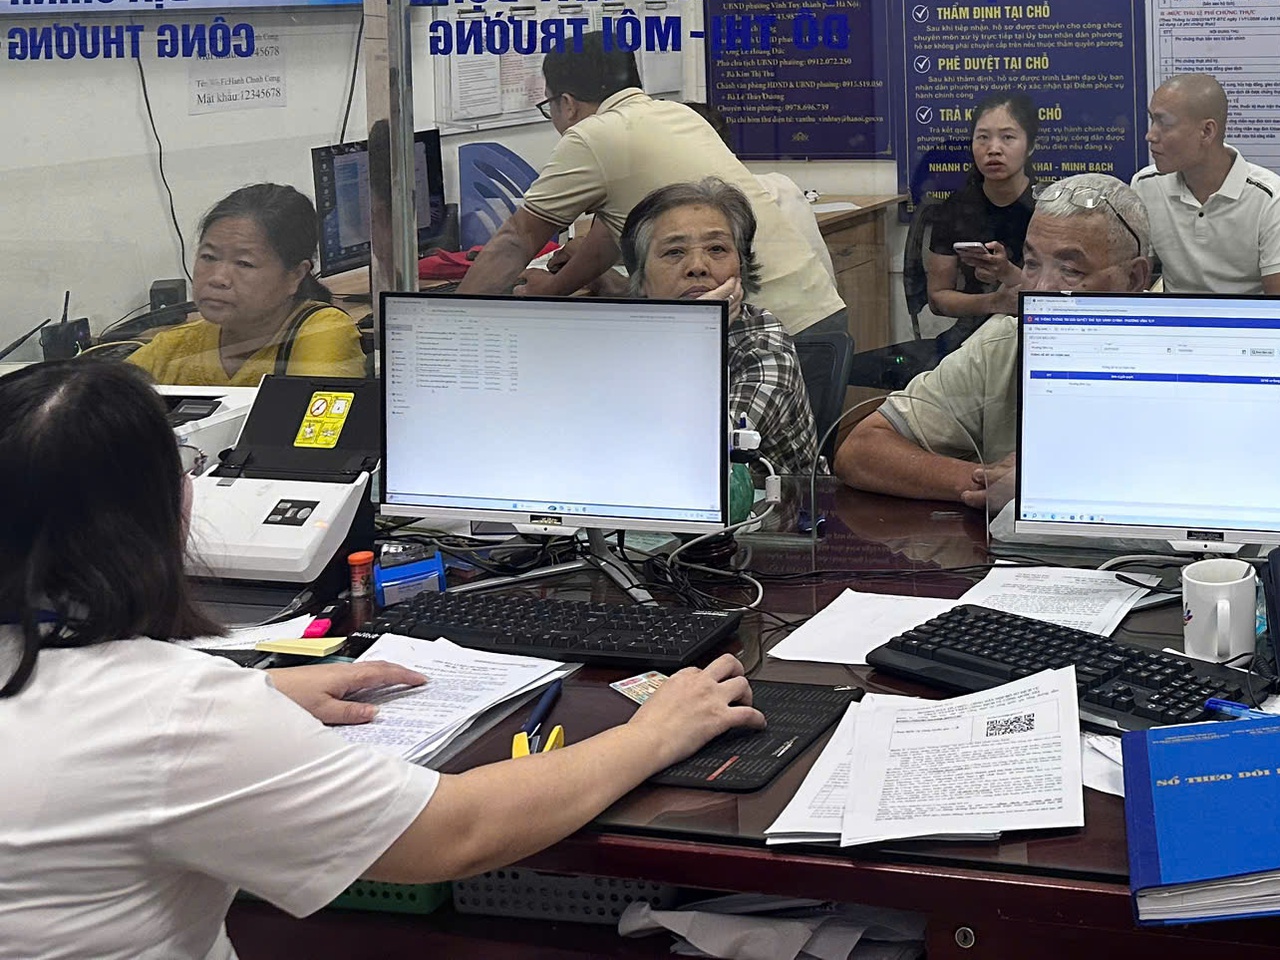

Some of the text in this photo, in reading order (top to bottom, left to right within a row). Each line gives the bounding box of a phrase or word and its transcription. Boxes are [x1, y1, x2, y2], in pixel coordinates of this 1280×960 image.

[936, 0, 1050, 22] THẨM ĐỊNH TẠI CHỖ
[937, 52, 1049, 73] PHÊ DUYỆT TẠI CHỖ
[939, 103, 1062, 121] TRẢ CHỖ
[928, 162, 1114, 172] NHANH MINH BẠCH
[1185, 772, 1232, 785] THEO
